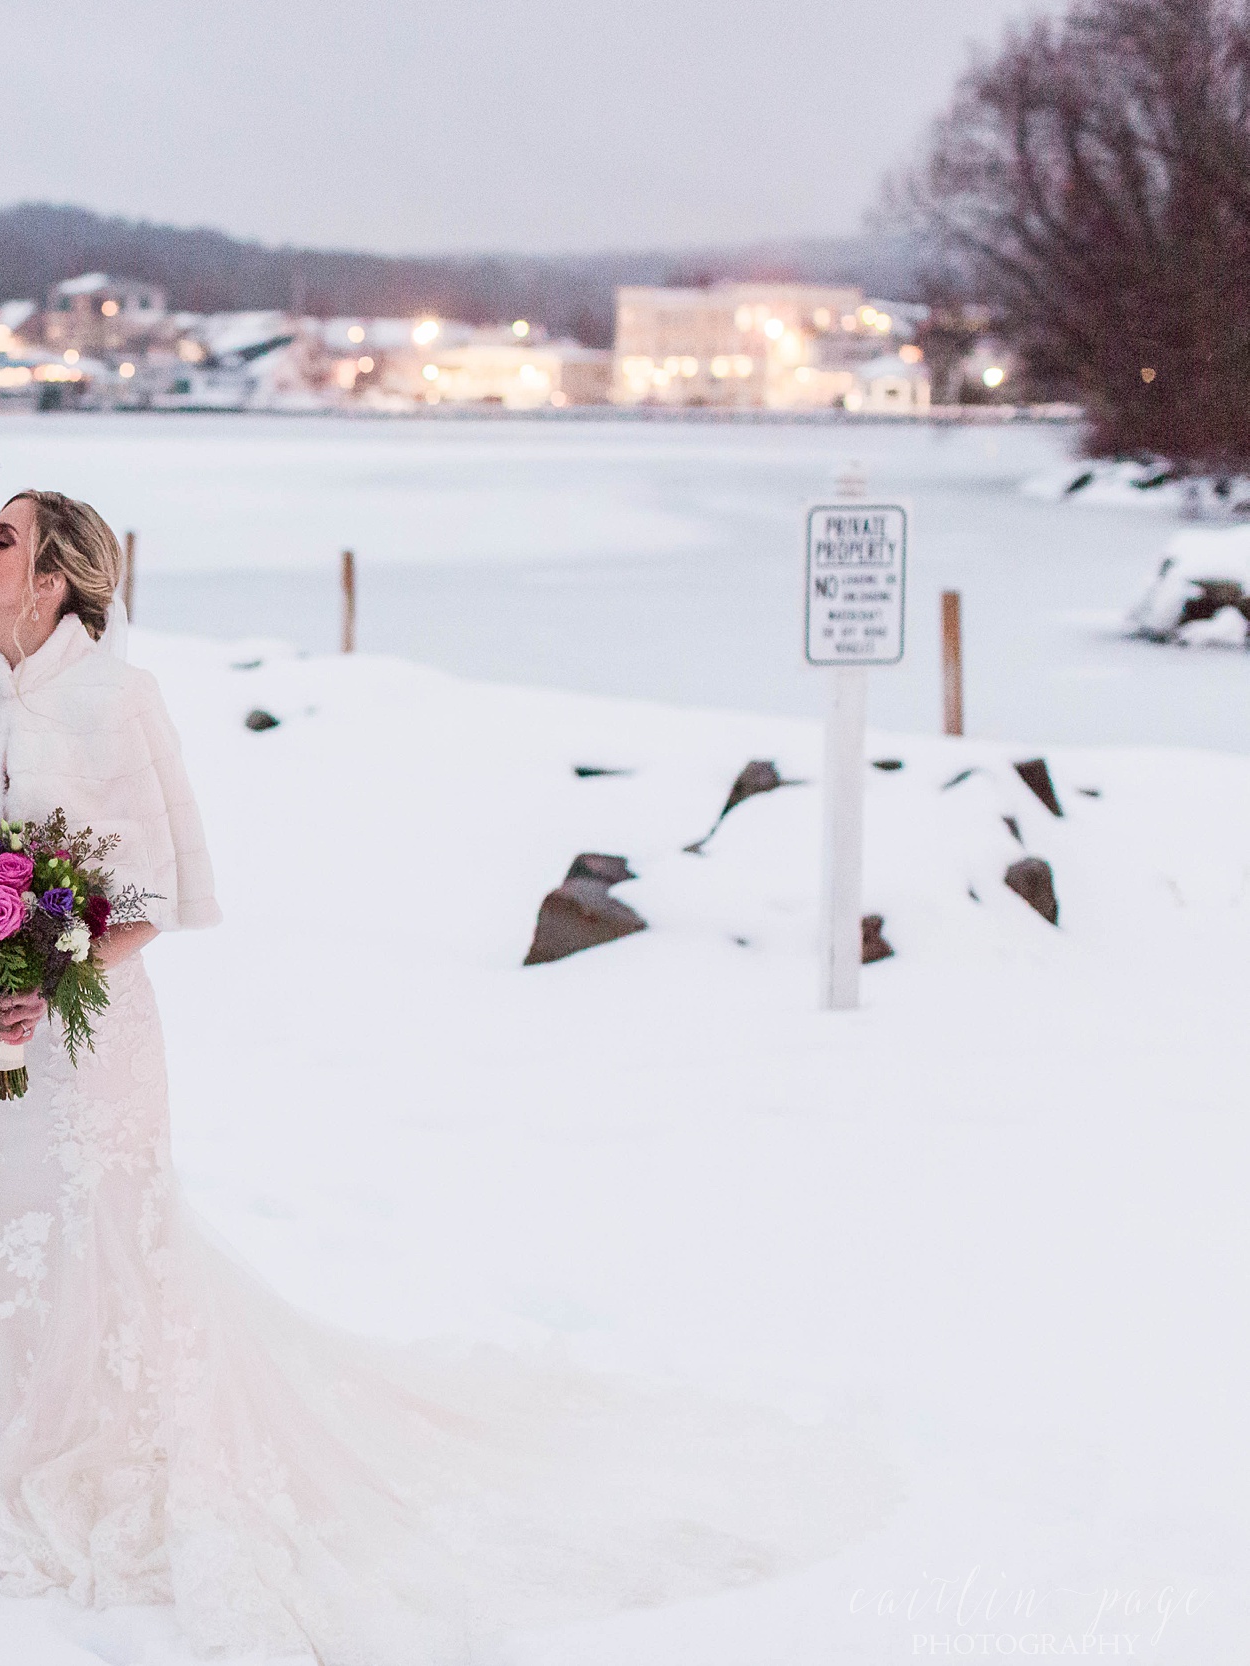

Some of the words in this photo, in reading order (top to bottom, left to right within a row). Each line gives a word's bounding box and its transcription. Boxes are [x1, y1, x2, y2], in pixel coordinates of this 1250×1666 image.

[825, 516, 886, 537] PRIVATE
[815, 540, 897, 561] PROPERTY
[815, 575, 839, 599] NO
